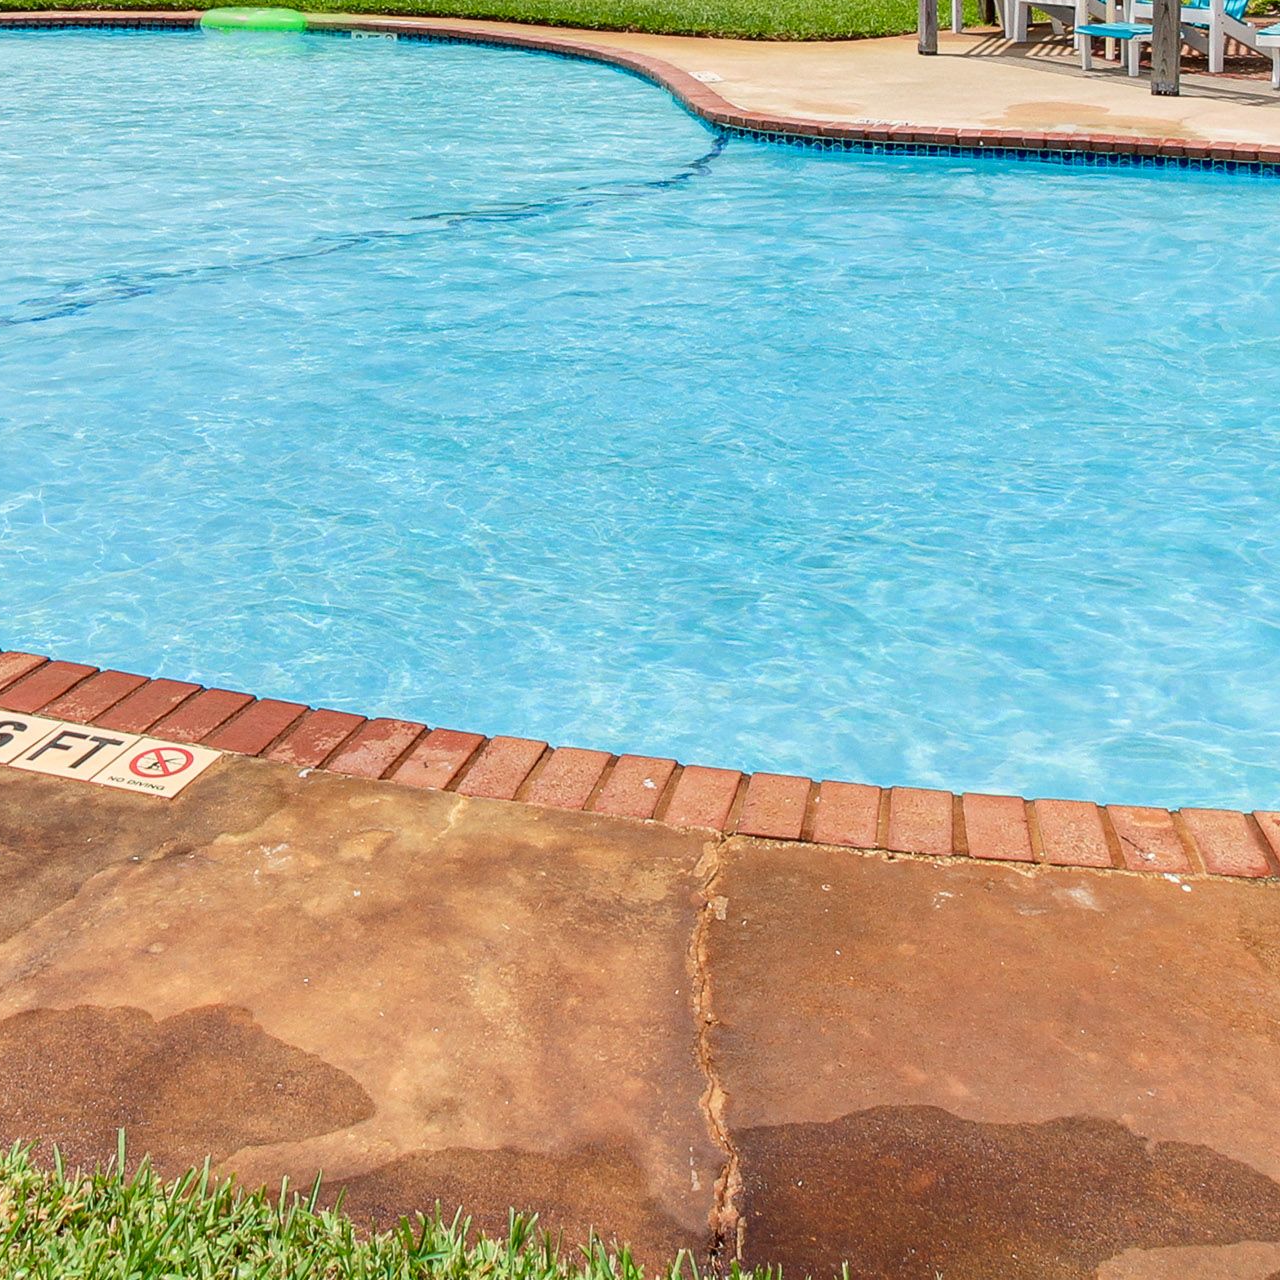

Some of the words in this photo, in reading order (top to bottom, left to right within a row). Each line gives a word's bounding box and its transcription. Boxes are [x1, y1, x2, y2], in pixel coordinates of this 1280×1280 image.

[26, 730, 124, 769] FT
[107, 775, 126, 783] NO
[127, 780, 165, 791] DIVING
